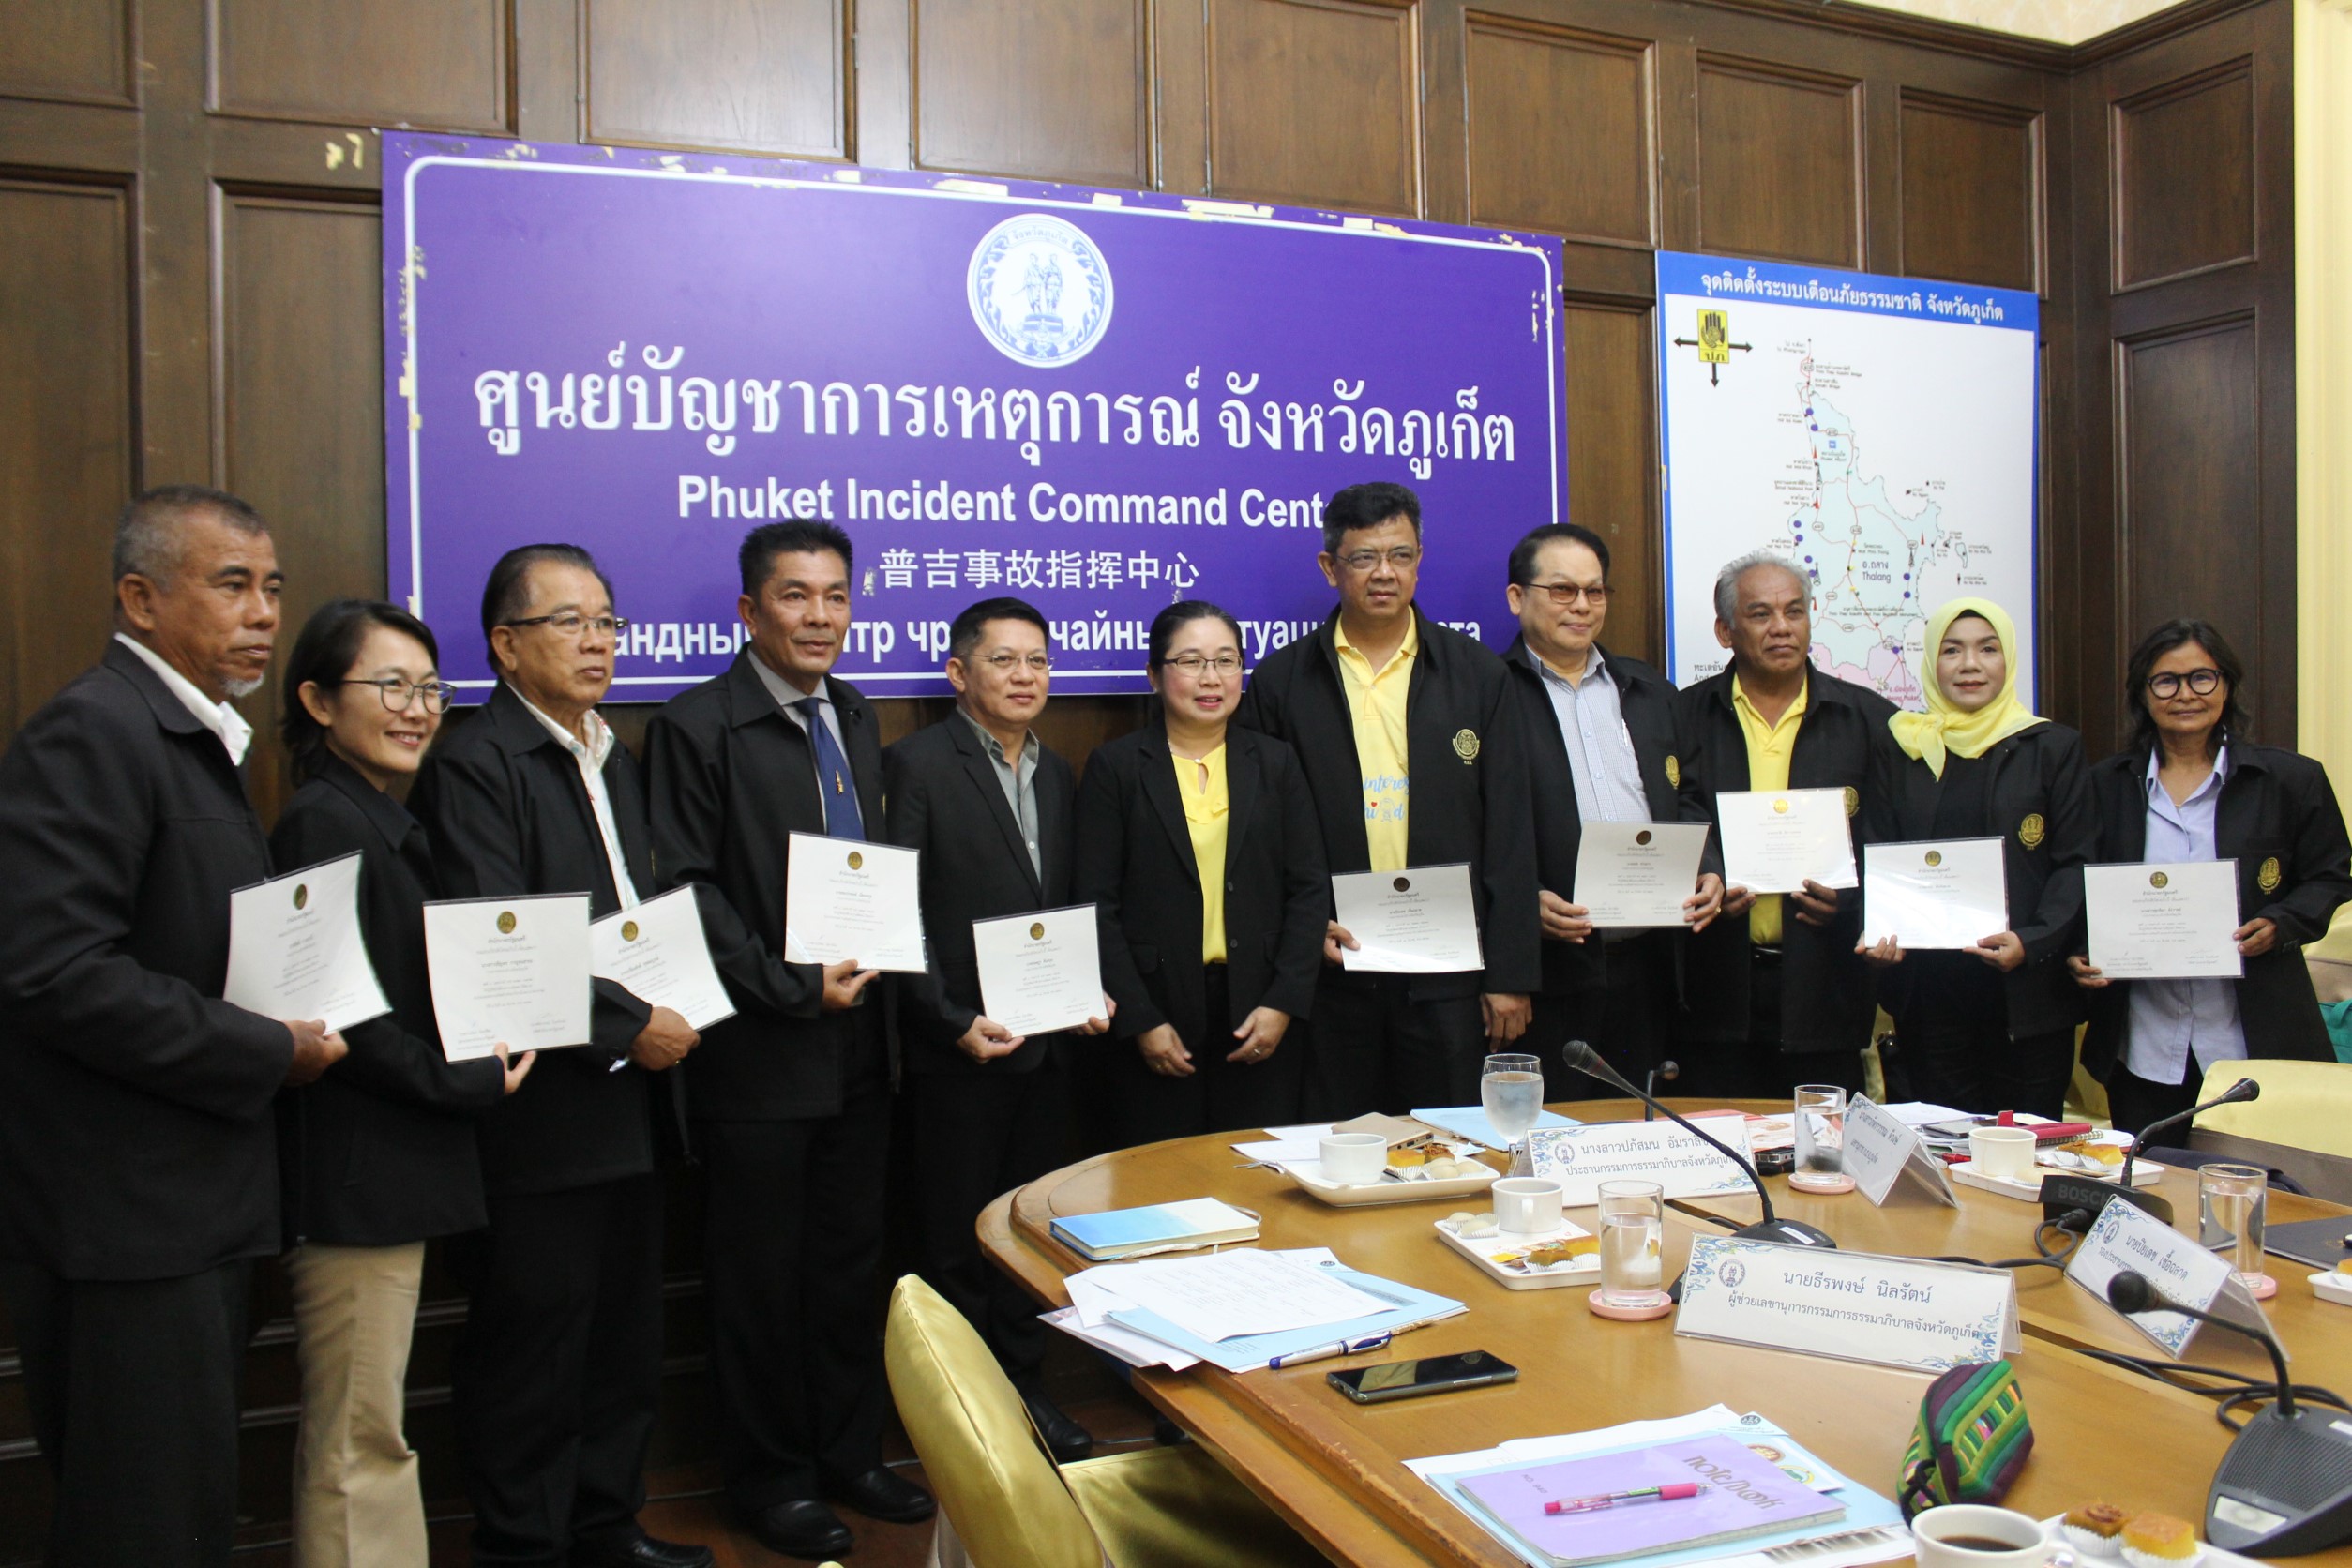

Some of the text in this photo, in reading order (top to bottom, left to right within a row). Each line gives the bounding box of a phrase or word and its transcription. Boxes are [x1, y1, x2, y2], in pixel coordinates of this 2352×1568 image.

[1926, 292, 2003, 324] จังหวัดภูเก็ต
[474, 341, 1515, 480] ศูนย์บัญชาการเหตุการณ์ จังหวัดภูเก็ต
[678, 475, 1330, 529] Phuket Incident Command Cent
[880, 548, 1200, 591] 普吉事故指挥中心
[1862, 571, 1892, 584] Thalang
[614, 623, 752, 662] андны
[1783, 1270, 1933, 1304] นายธีรพงษ์ นิลรัตน์
